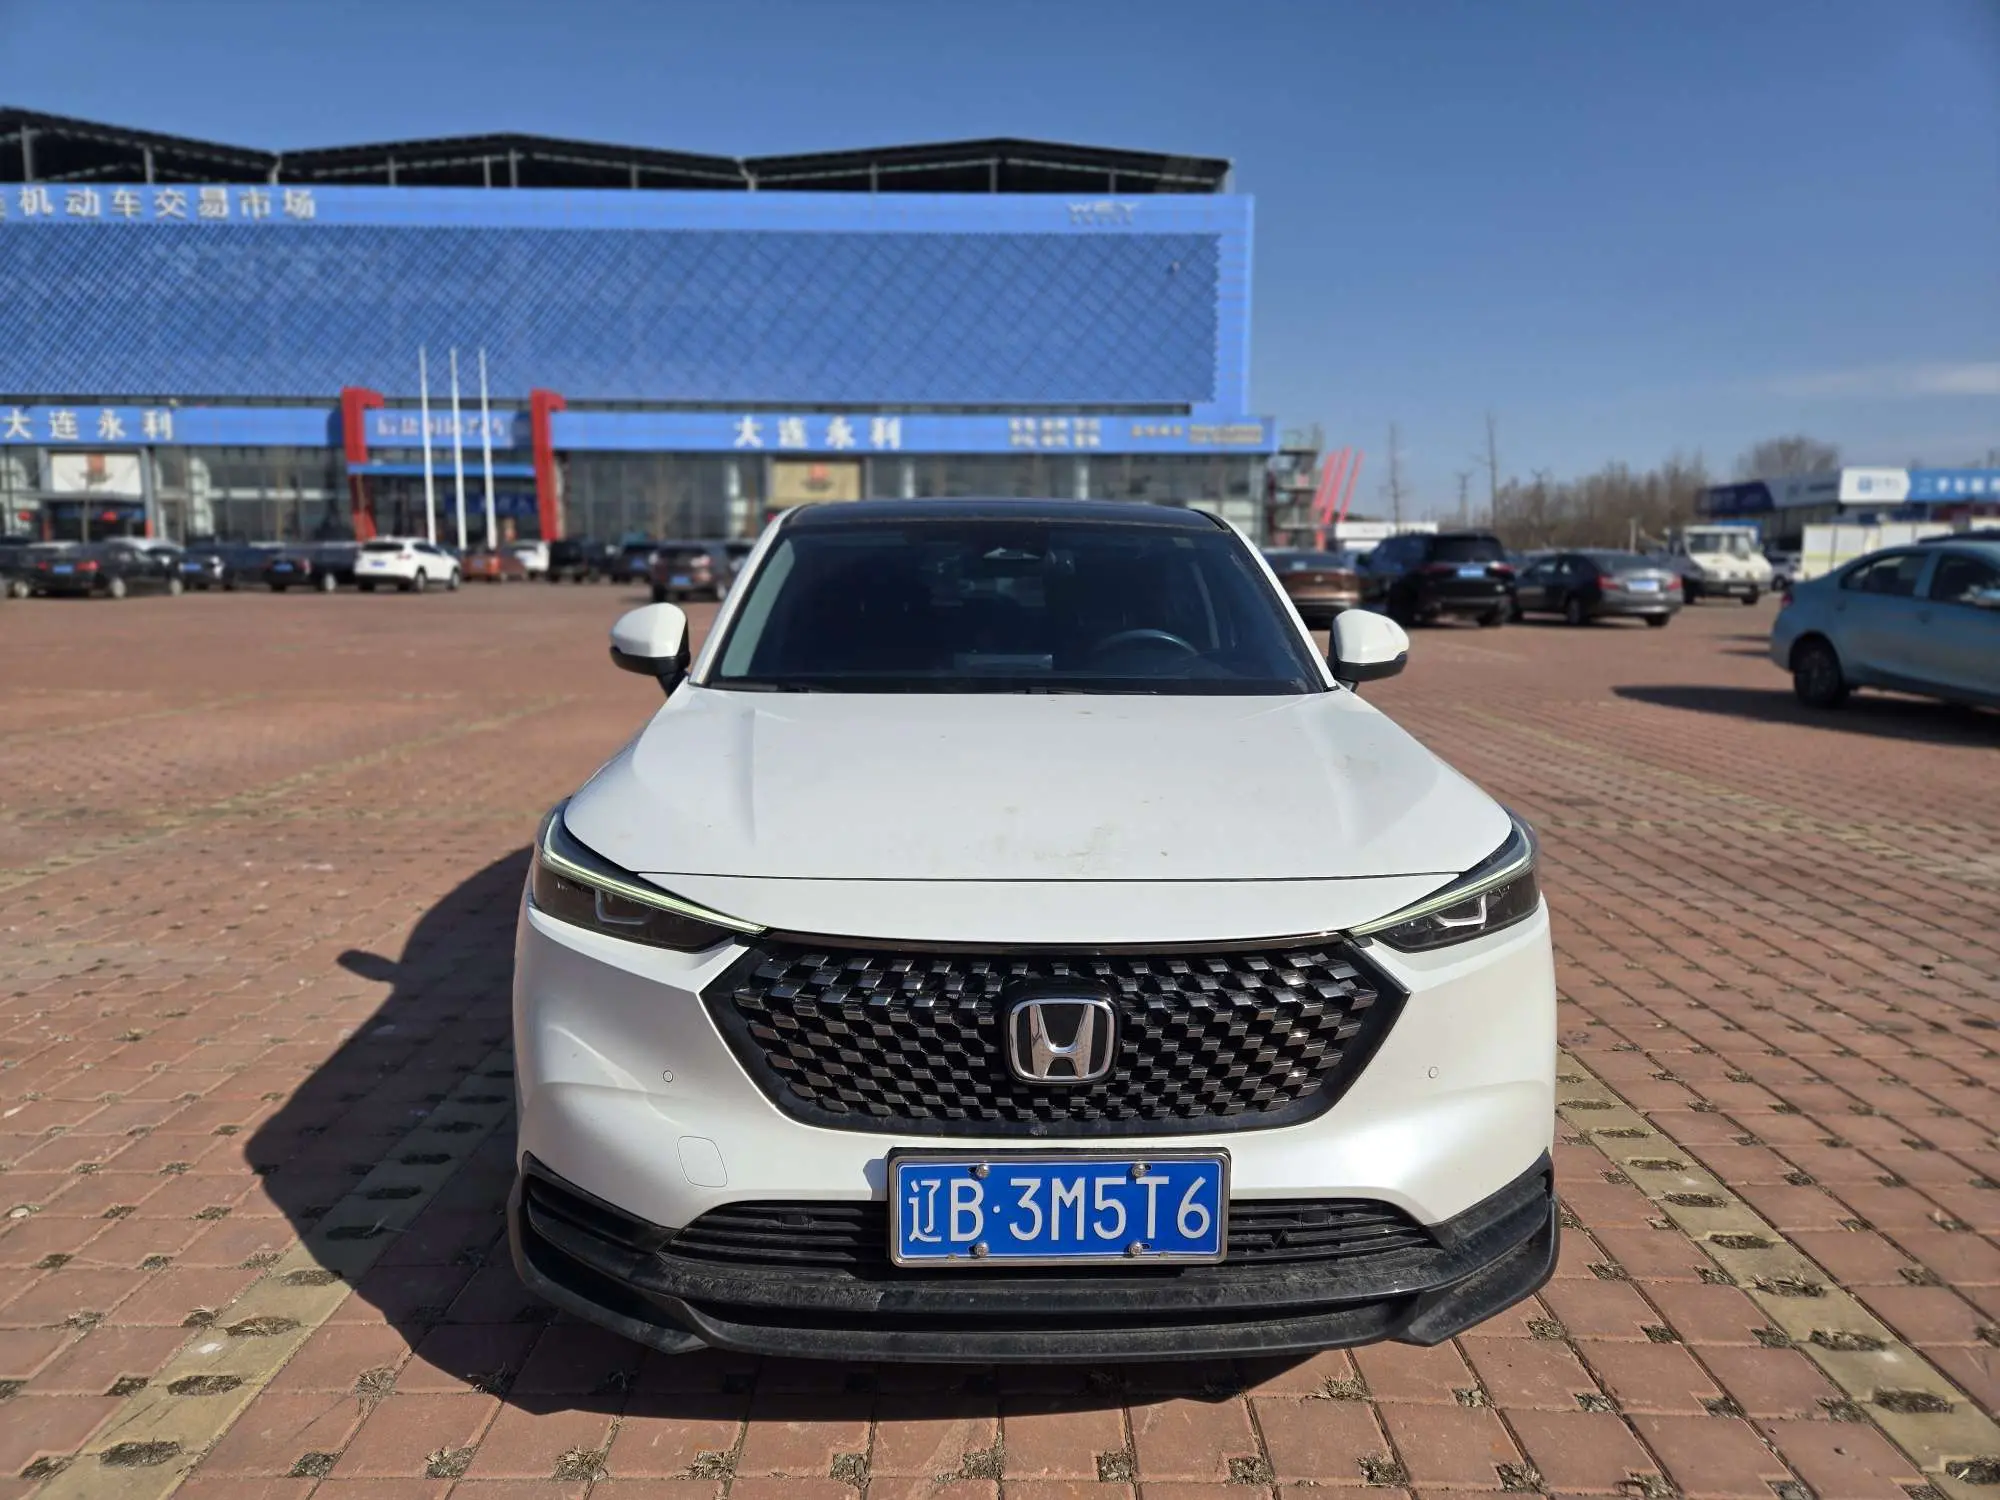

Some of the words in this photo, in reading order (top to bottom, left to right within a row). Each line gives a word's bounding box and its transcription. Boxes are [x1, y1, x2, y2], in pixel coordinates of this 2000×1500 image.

[0, 185, 316, 219] 机动车交易市场
[2, 407, 174, 441] 大连永利
[908, 1175, 1211, 1243] 辽B·3M5T6
